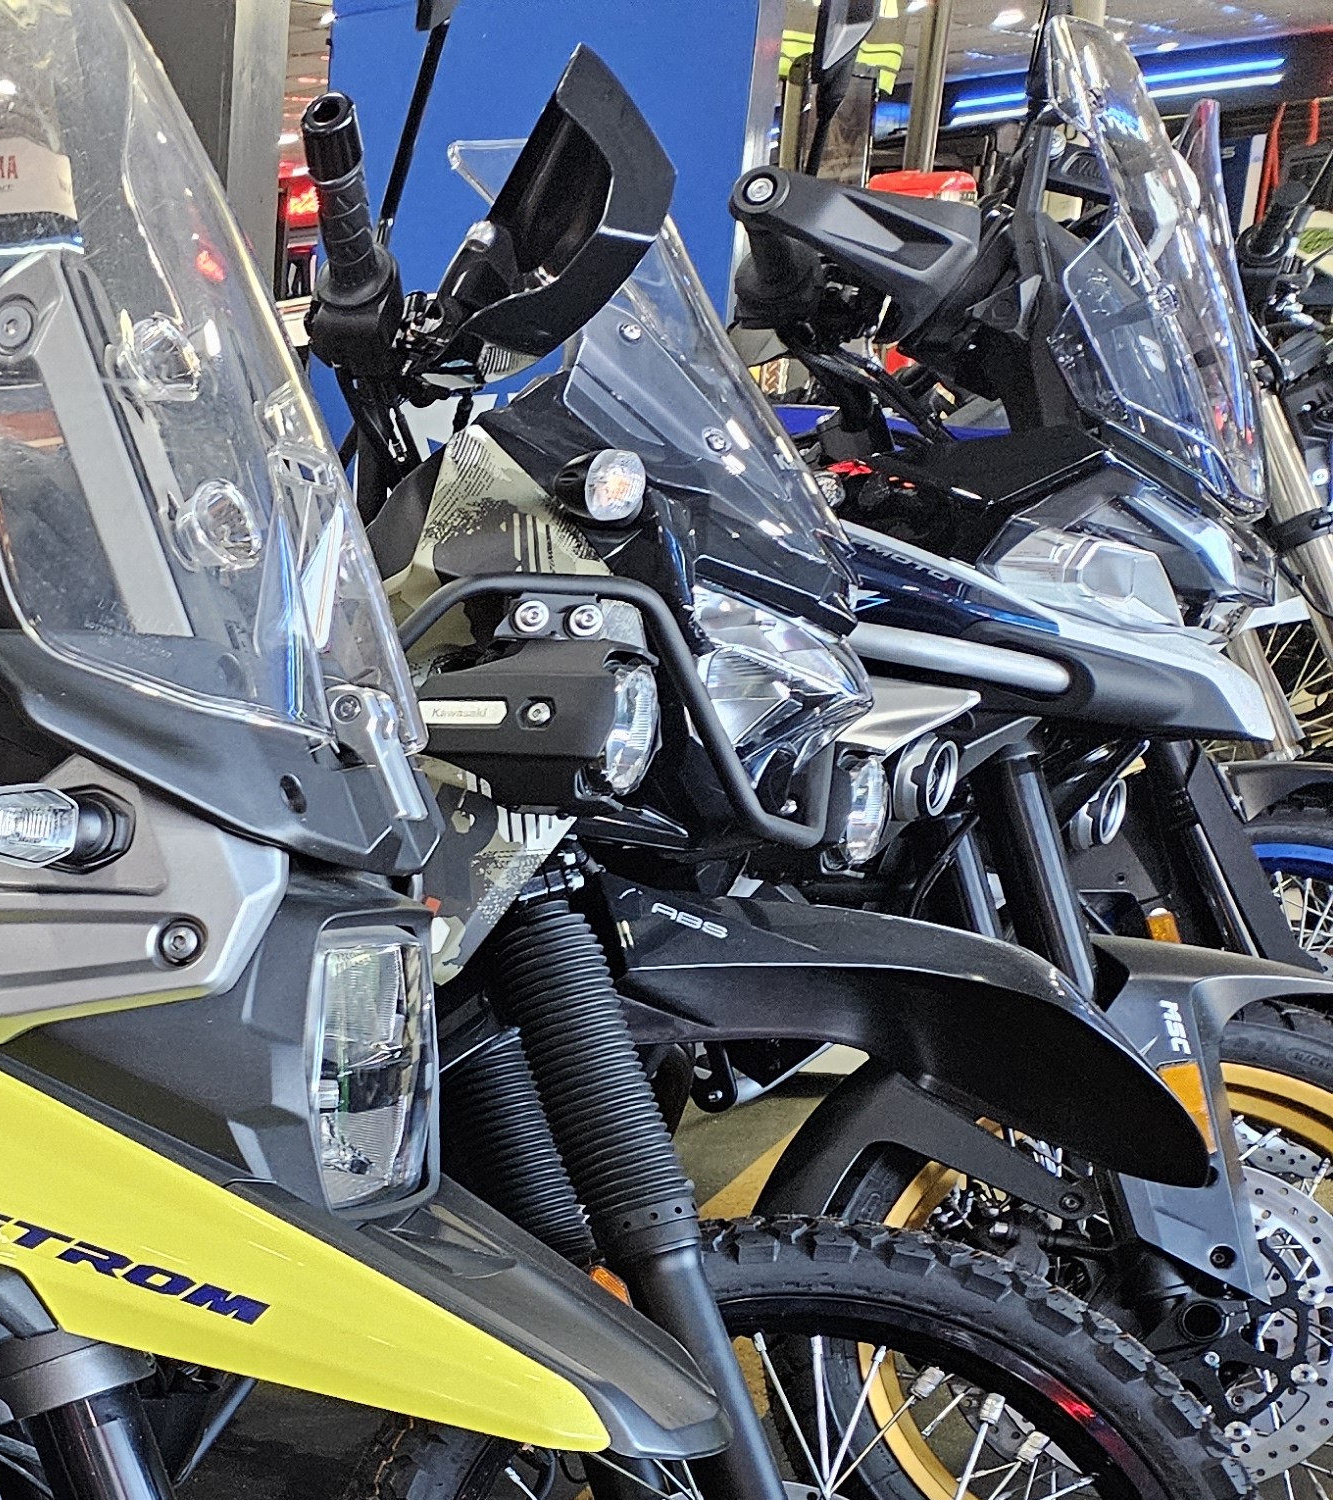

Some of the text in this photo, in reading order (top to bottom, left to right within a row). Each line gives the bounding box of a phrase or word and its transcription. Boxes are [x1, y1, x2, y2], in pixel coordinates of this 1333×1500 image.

[850, 536, 954, 582] FMOTO
[651, 902, 729, 939] ABS
[1159, 999, 1192, 1055] MSC
